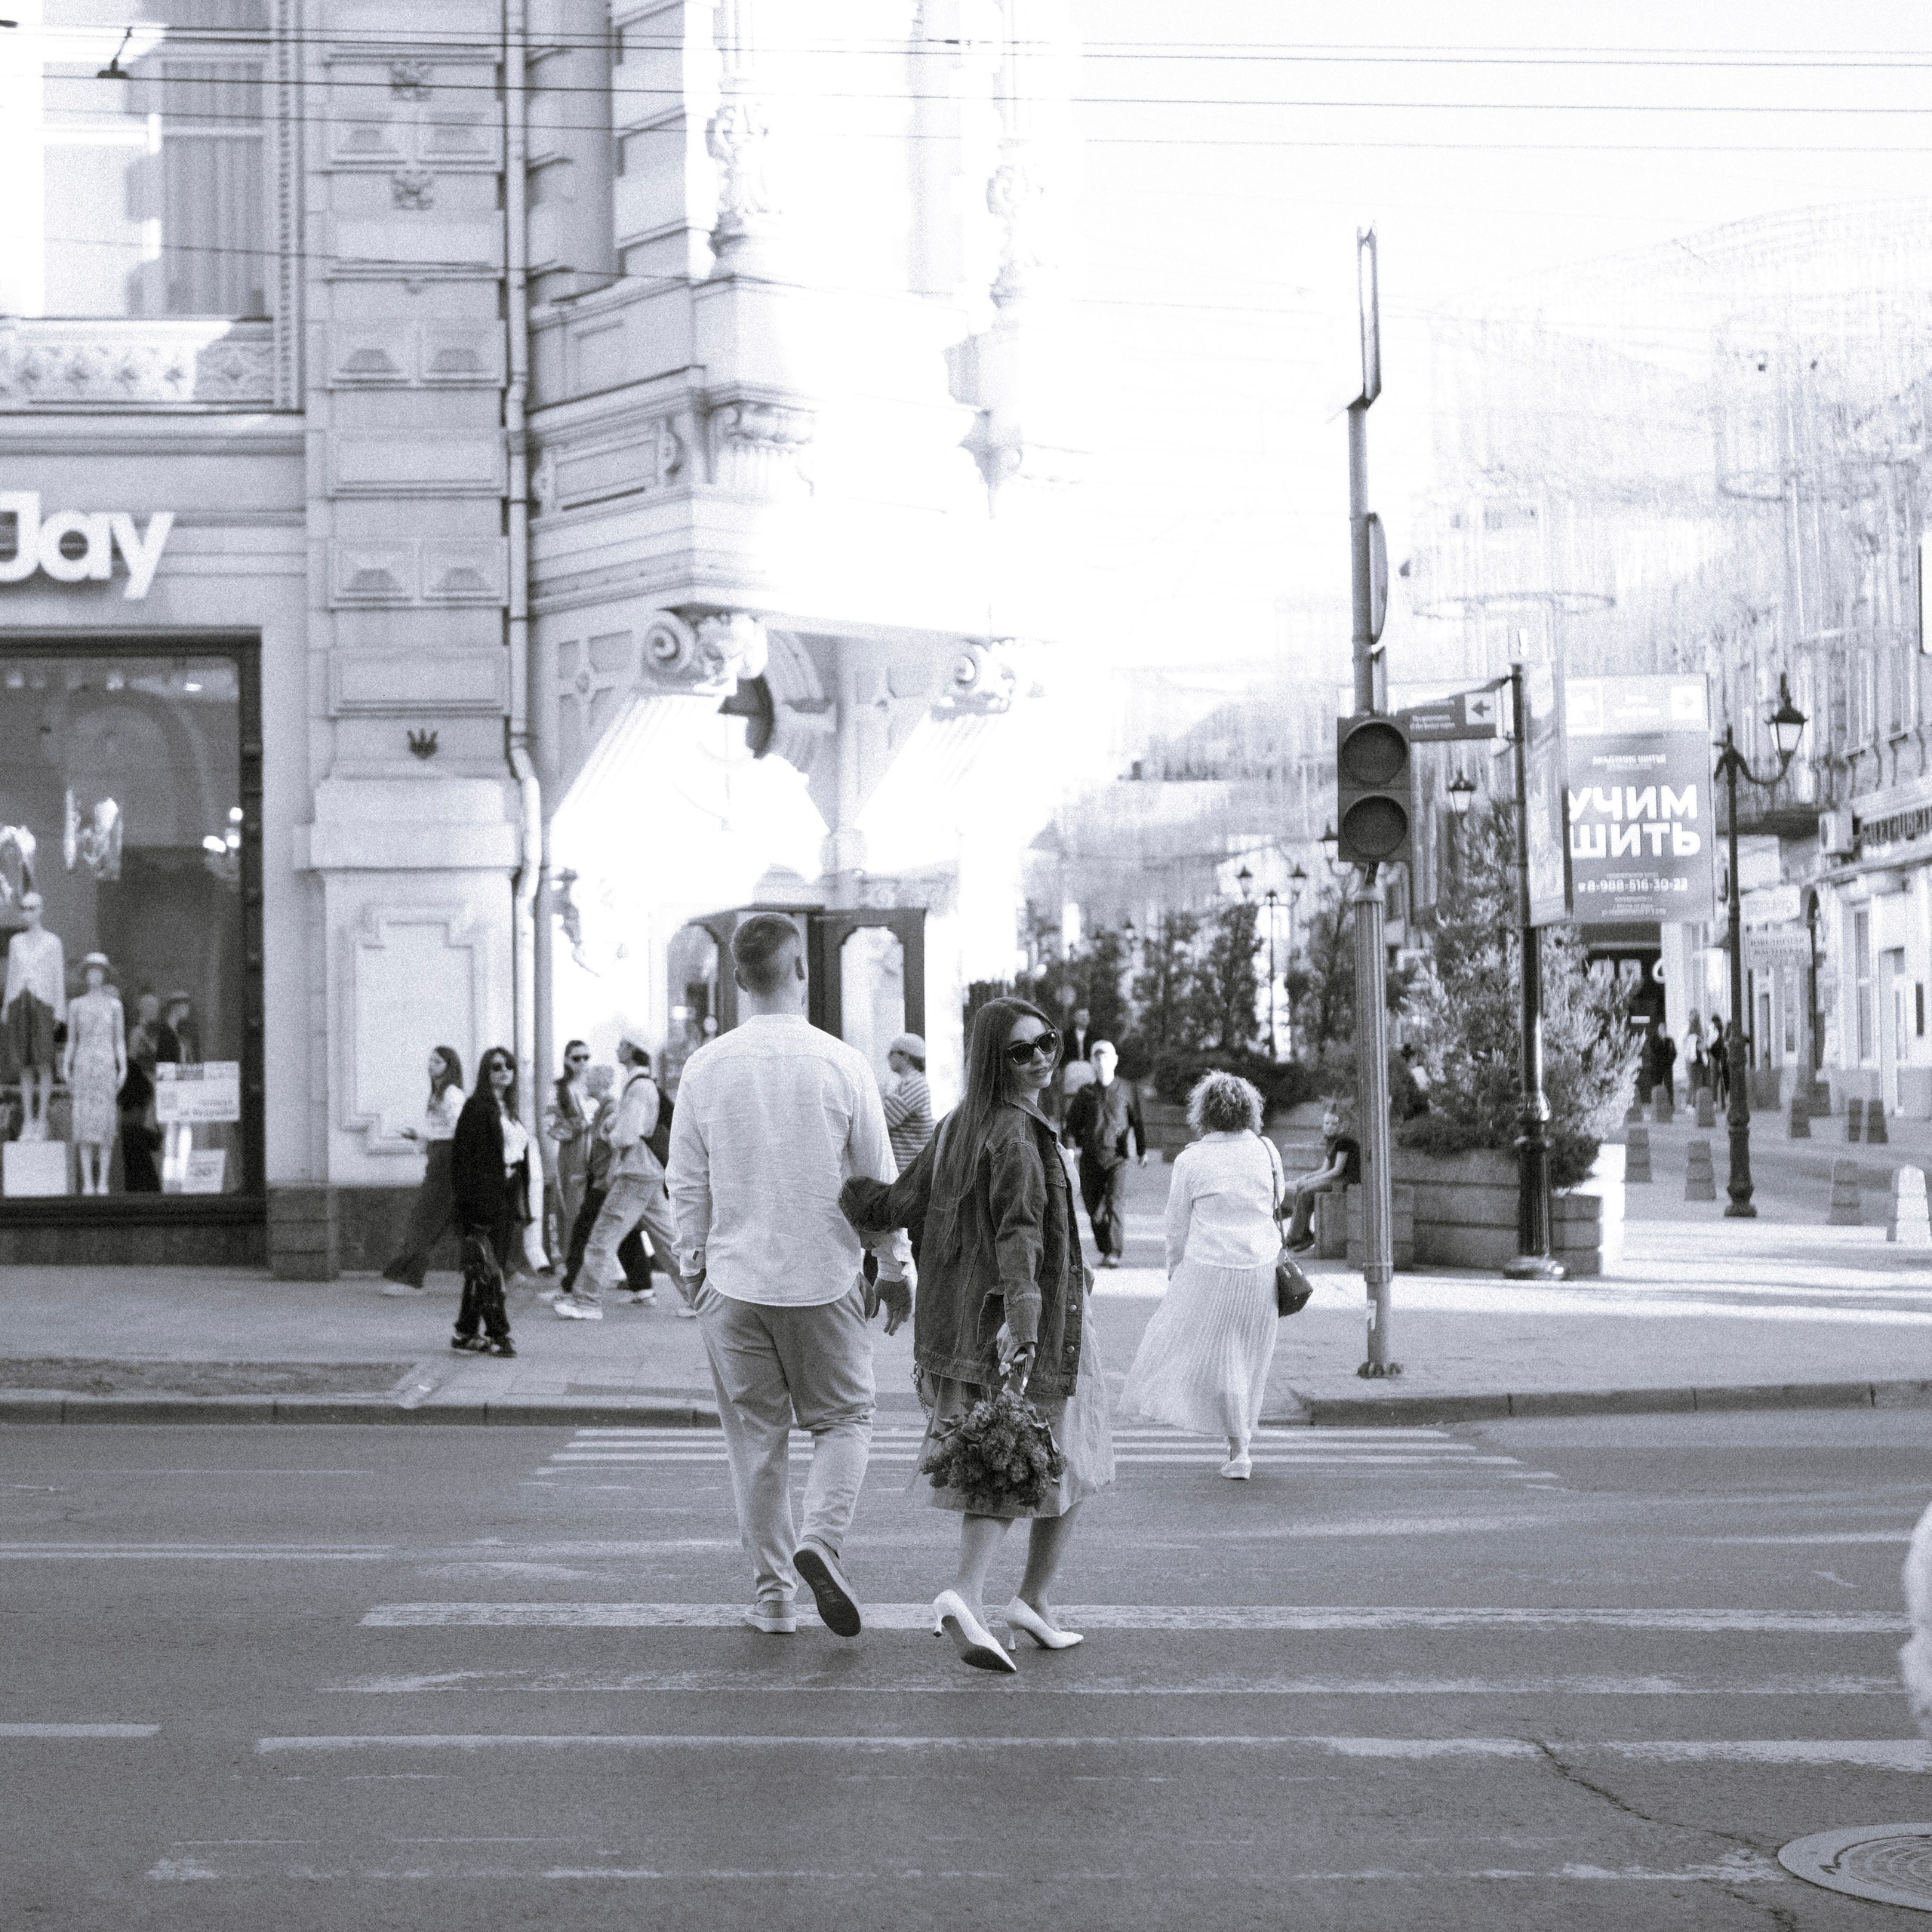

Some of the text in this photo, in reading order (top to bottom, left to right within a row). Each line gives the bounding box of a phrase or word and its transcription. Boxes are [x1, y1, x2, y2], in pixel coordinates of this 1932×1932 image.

[0, 491, 175, 600] Jay
[1568, 784, 1697, 823] УЧИМ
[1570, 822, 1701, 859] ШИТЬ
